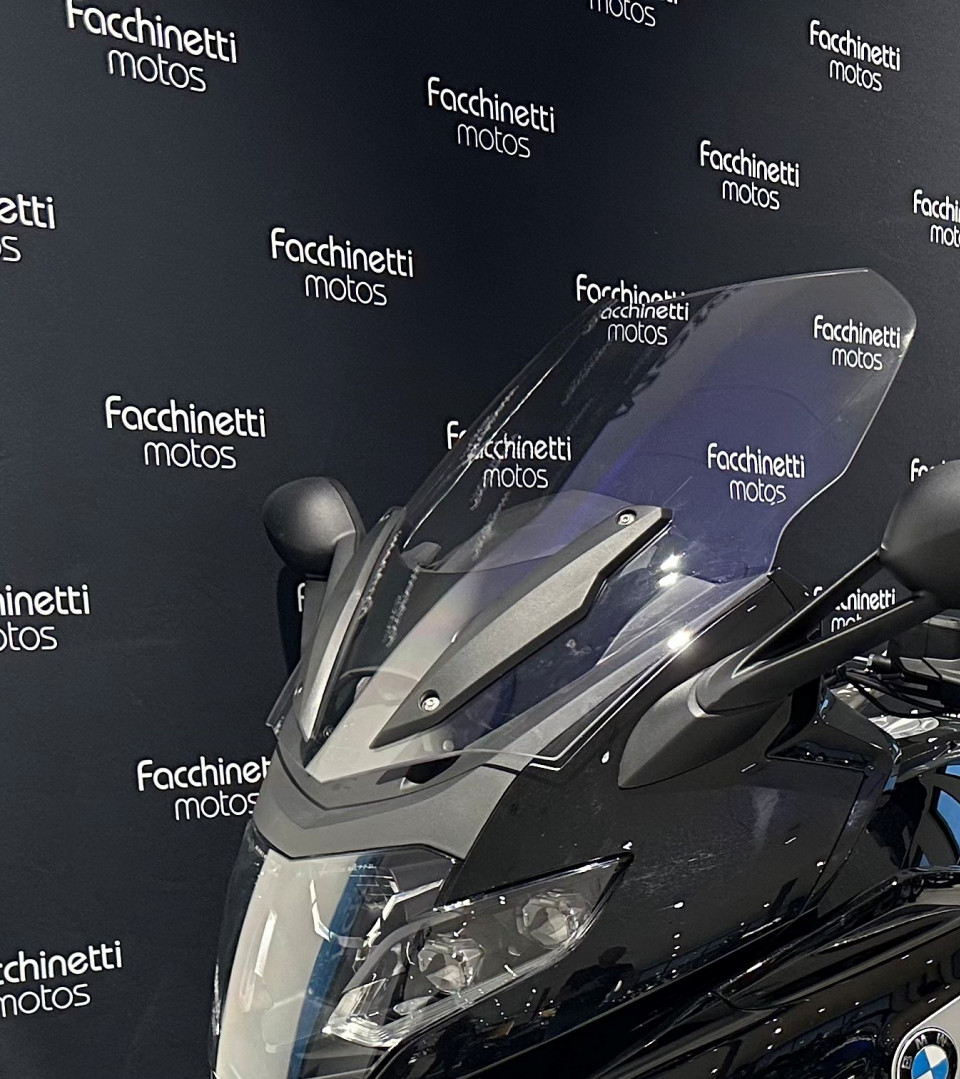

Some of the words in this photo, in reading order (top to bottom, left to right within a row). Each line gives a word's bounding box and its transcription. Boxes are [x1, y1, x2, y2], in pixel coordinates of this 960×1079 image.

[810, 20, 901, 71] Facchinetti
[108, 50, 207, 92] motos
[829, 60, 883, 92] motos
[428, 77, 555, 134] Facchinetti
[457, 124, 531, 159] motos
[700, 140, 800, 188] Facchinetti
[722, 180, 780, 211] motos
[271, 227, 414, 278] Facchinetti
[304, 274, 388, 306] motos
[607, 321, 668, 346] motos
[814, 315, 901, 350] Facchinetti
[831, 346, 883, 372] motos
[106, 396, 266, 438] Facchinetti
[143, 438, 237, 469] motos
[707, 442, 805, 479] Facchinetti
[483, 463, 549, 489] motos
[729, 478, 787, 504] motos
[0, 940, 122, 985] chinetti
[900, 1033, 950, 1070] BMW
